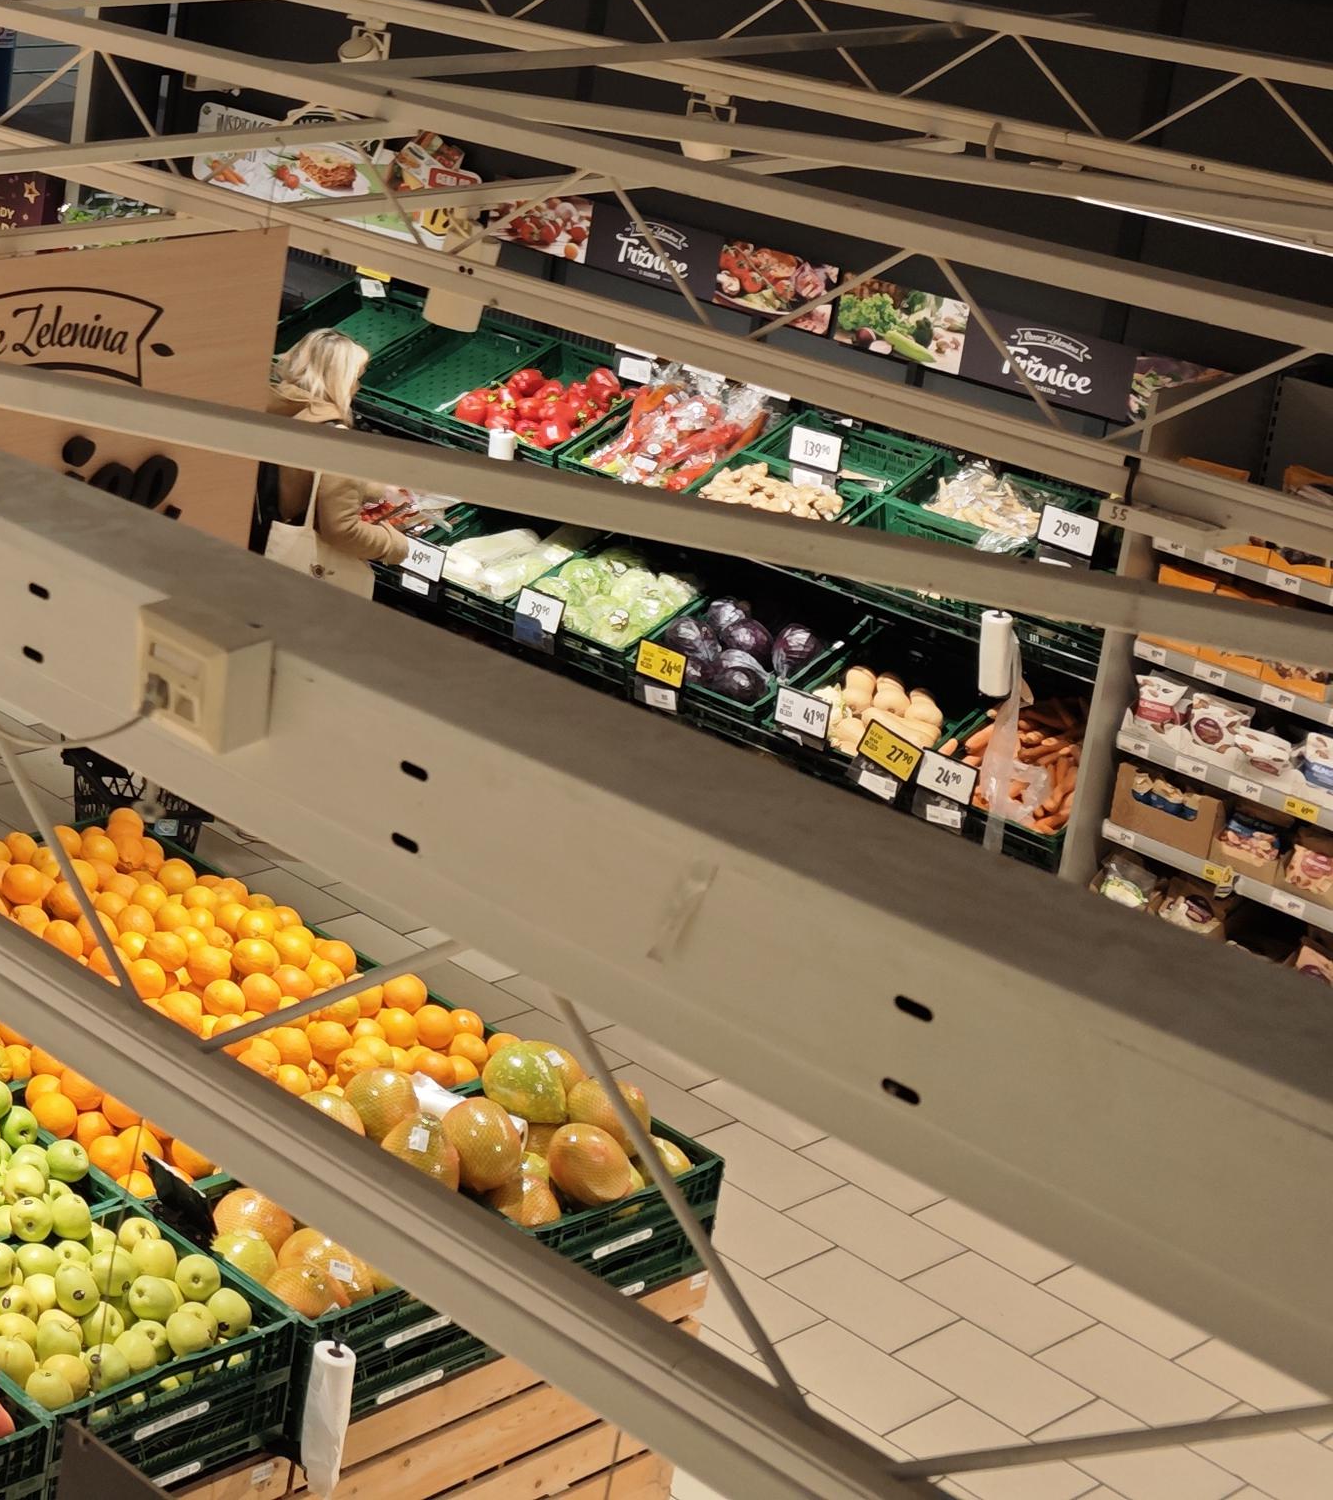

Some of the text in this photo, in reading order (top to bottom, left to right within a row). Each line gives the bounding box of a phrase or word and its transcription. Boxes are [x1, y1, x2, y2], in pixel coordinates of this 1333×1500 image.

[12, 303, 129, 357] Zelenina
[1053, 519, 1081, 538] 2990
[803, 707, 826, 725] 4190
[885, 744, 914, 765] 2790
[935, 766, 962, 787] 2490
